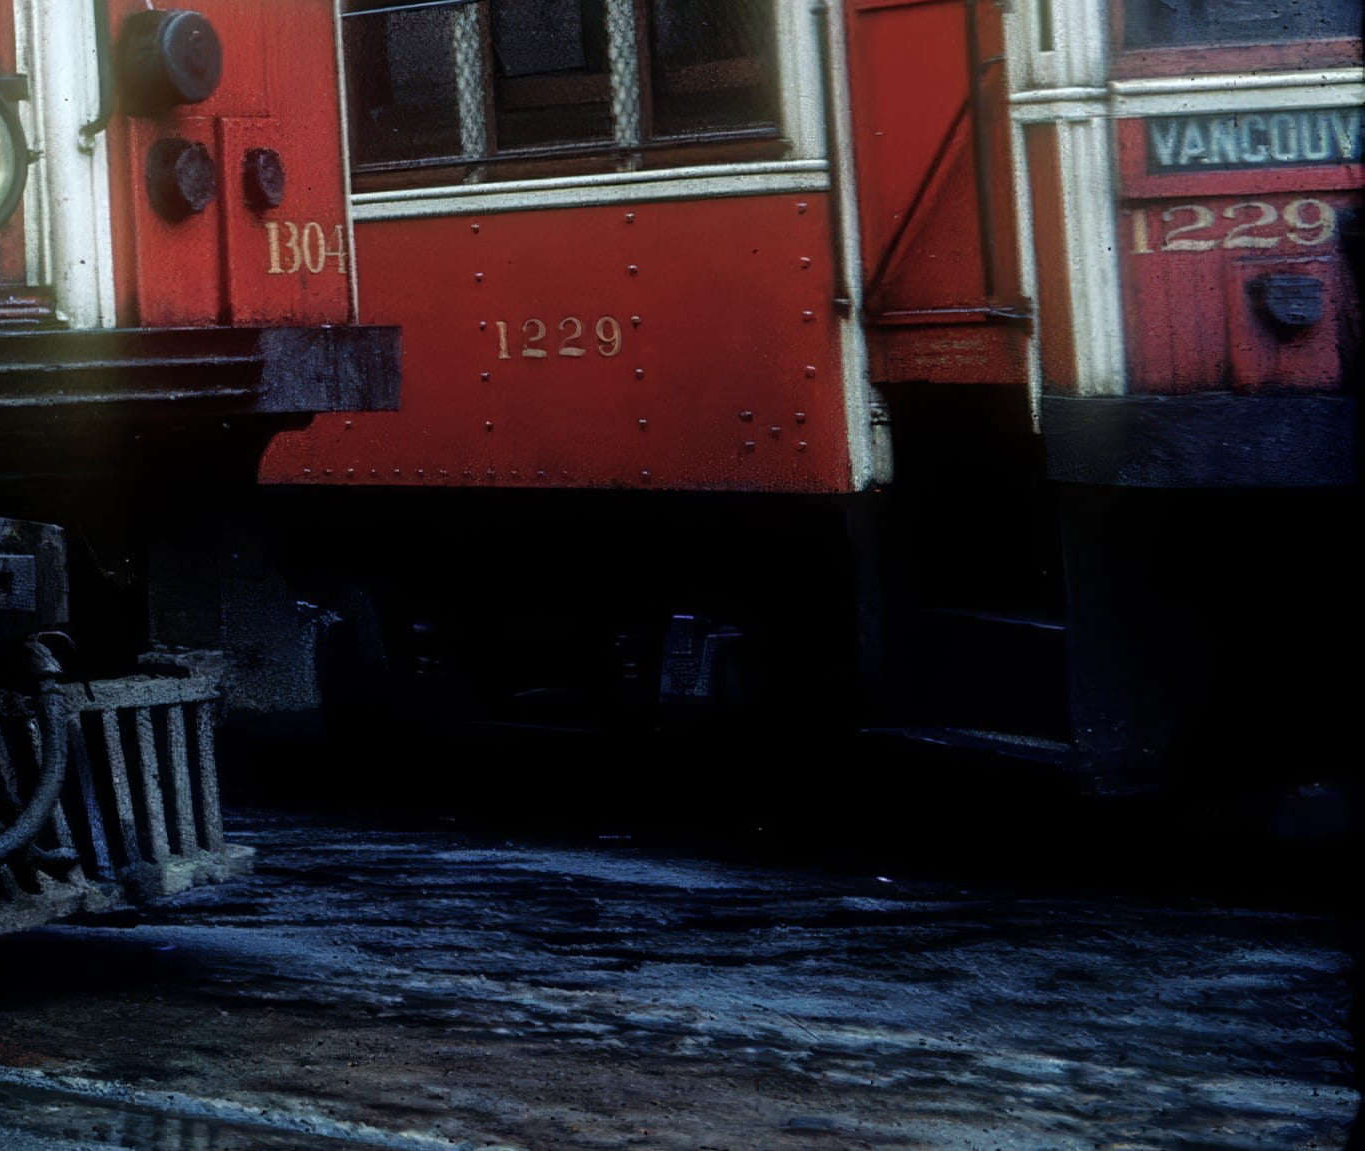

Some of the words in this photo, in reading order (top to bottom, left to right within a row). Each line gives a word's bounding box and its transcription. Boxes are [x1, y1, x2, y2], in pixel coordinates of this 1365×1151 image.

[264, 220, 348, 274] 1304
[1122, 198, 1338, 255] 1229
[495, 316, 622, 360] 1229
